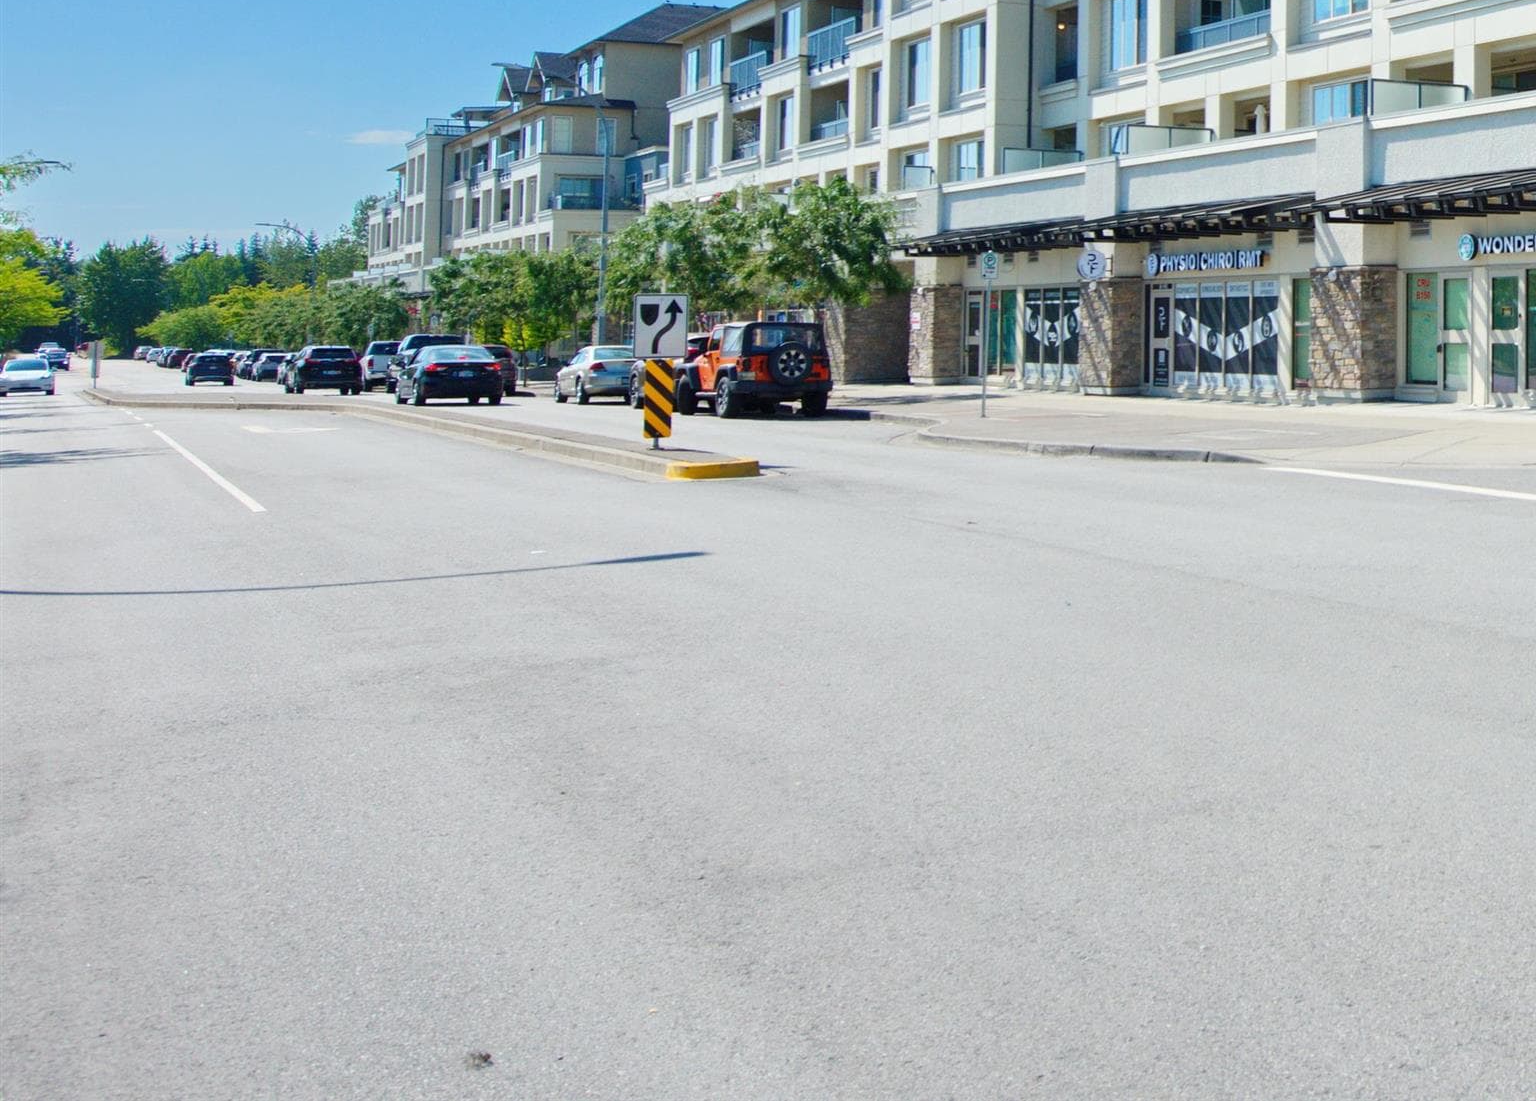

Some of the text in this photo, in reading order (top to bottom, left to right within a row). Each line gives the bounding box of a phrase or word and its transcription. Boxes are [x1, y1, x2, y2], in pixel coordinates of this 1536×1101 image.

[1160, 250, 1261, 273] PHYSIO CHIRO RMT
